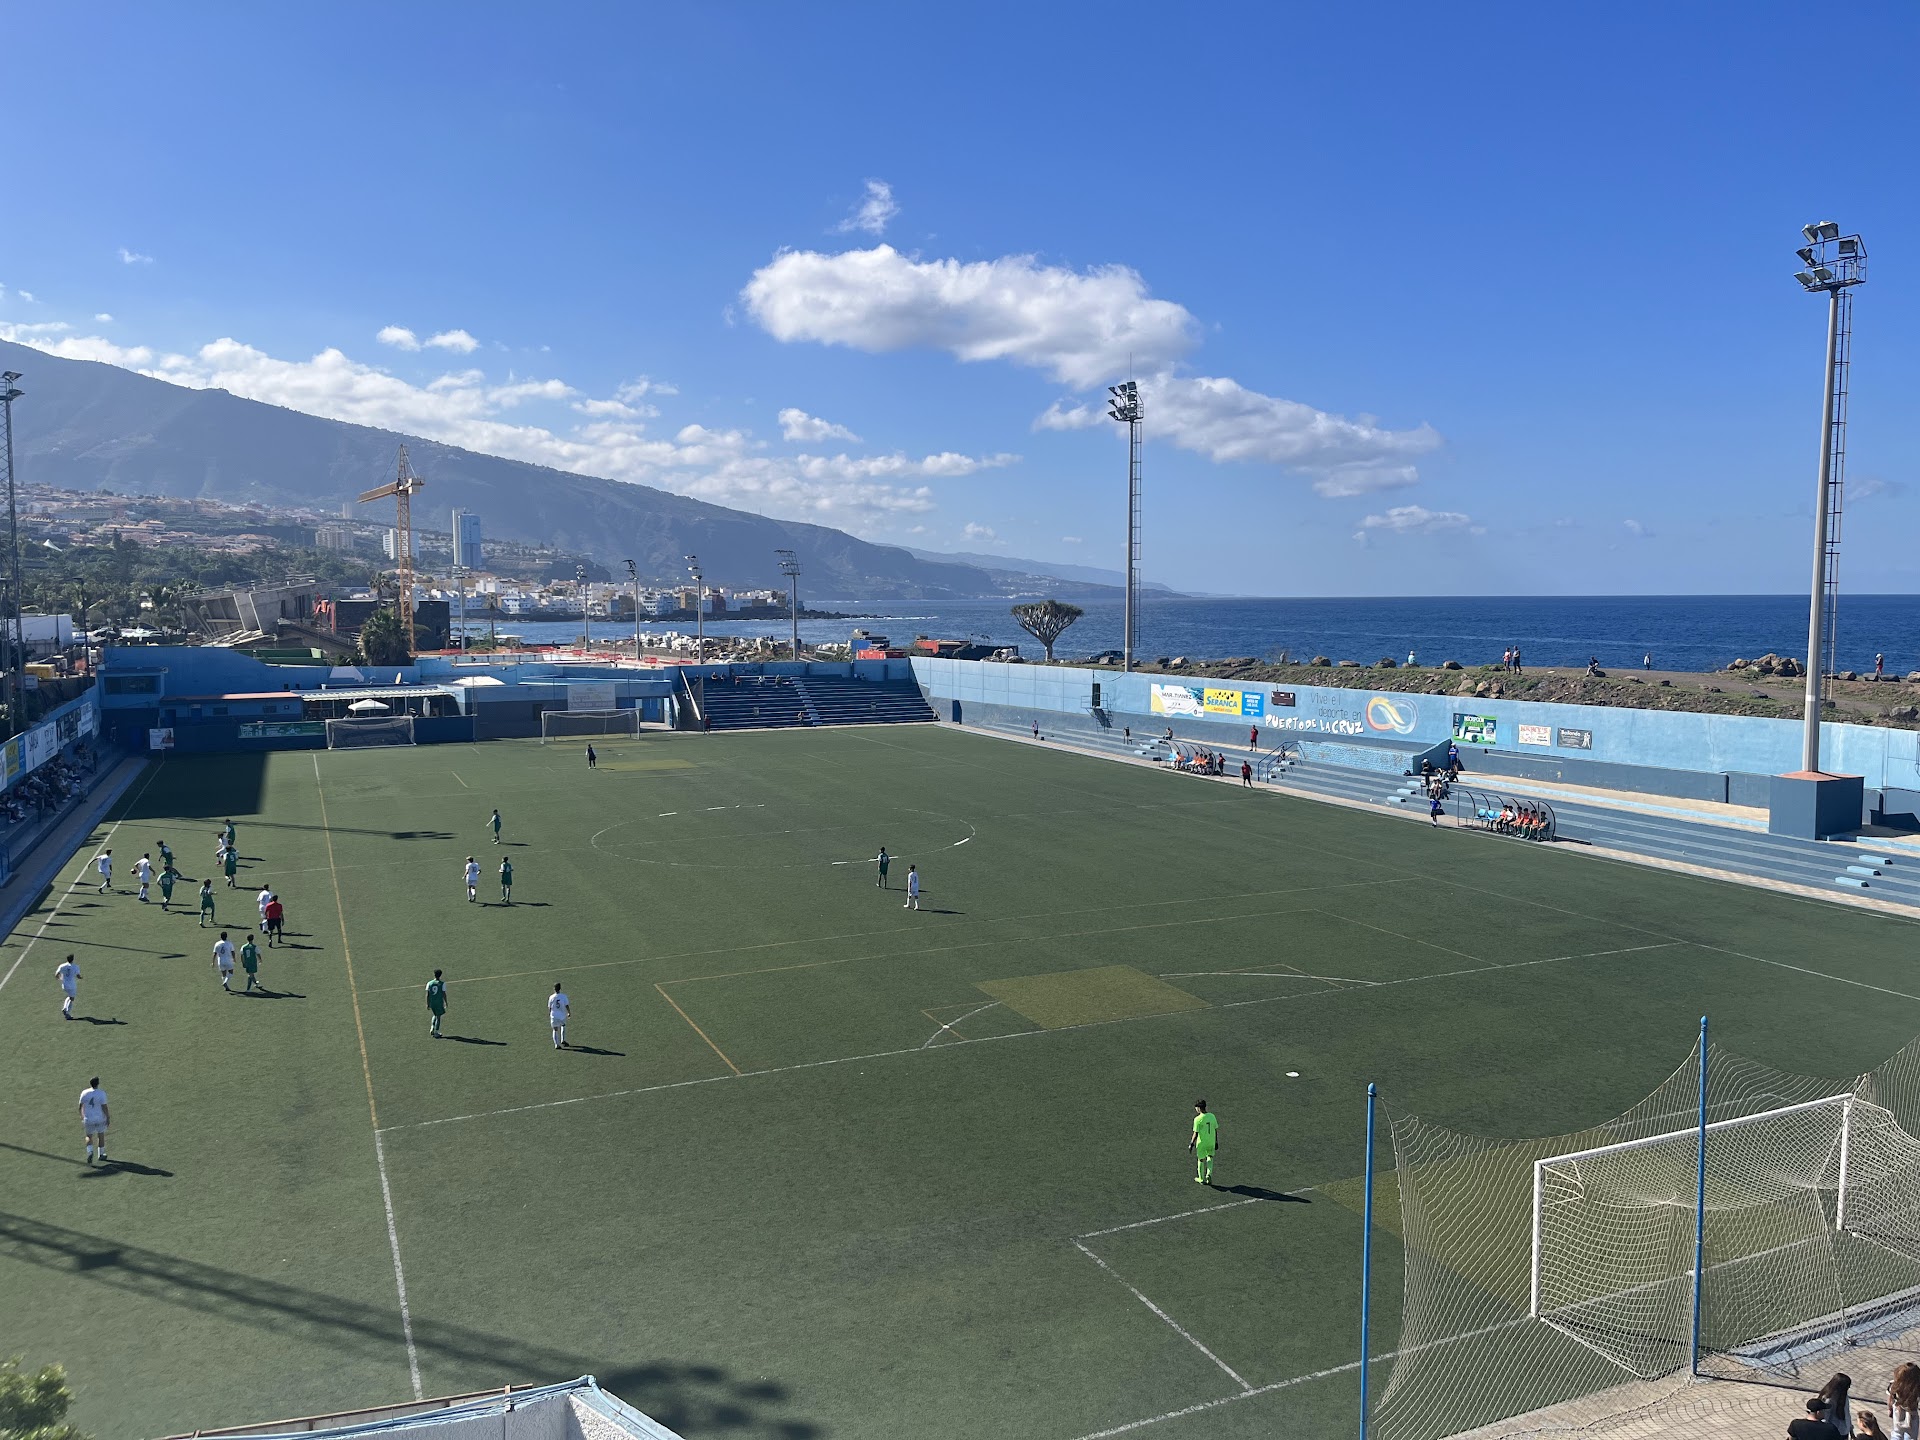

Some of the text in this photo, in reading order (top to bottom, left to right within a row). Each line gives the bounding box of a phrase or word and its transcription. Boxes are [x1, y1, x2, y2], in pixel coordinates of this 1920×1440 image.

[1206, 695, 1238, 708] SERANCA
[1310, 693, 1341, 705] Vive el
[1318, 706, 1362, 721] deporte en
[1265, 714, 1304, 730] PUERTO
[432, 985, 438, 995] 9
[555, 999, 561, 1009] 5
[88, 1097, 95, 1109] 4
